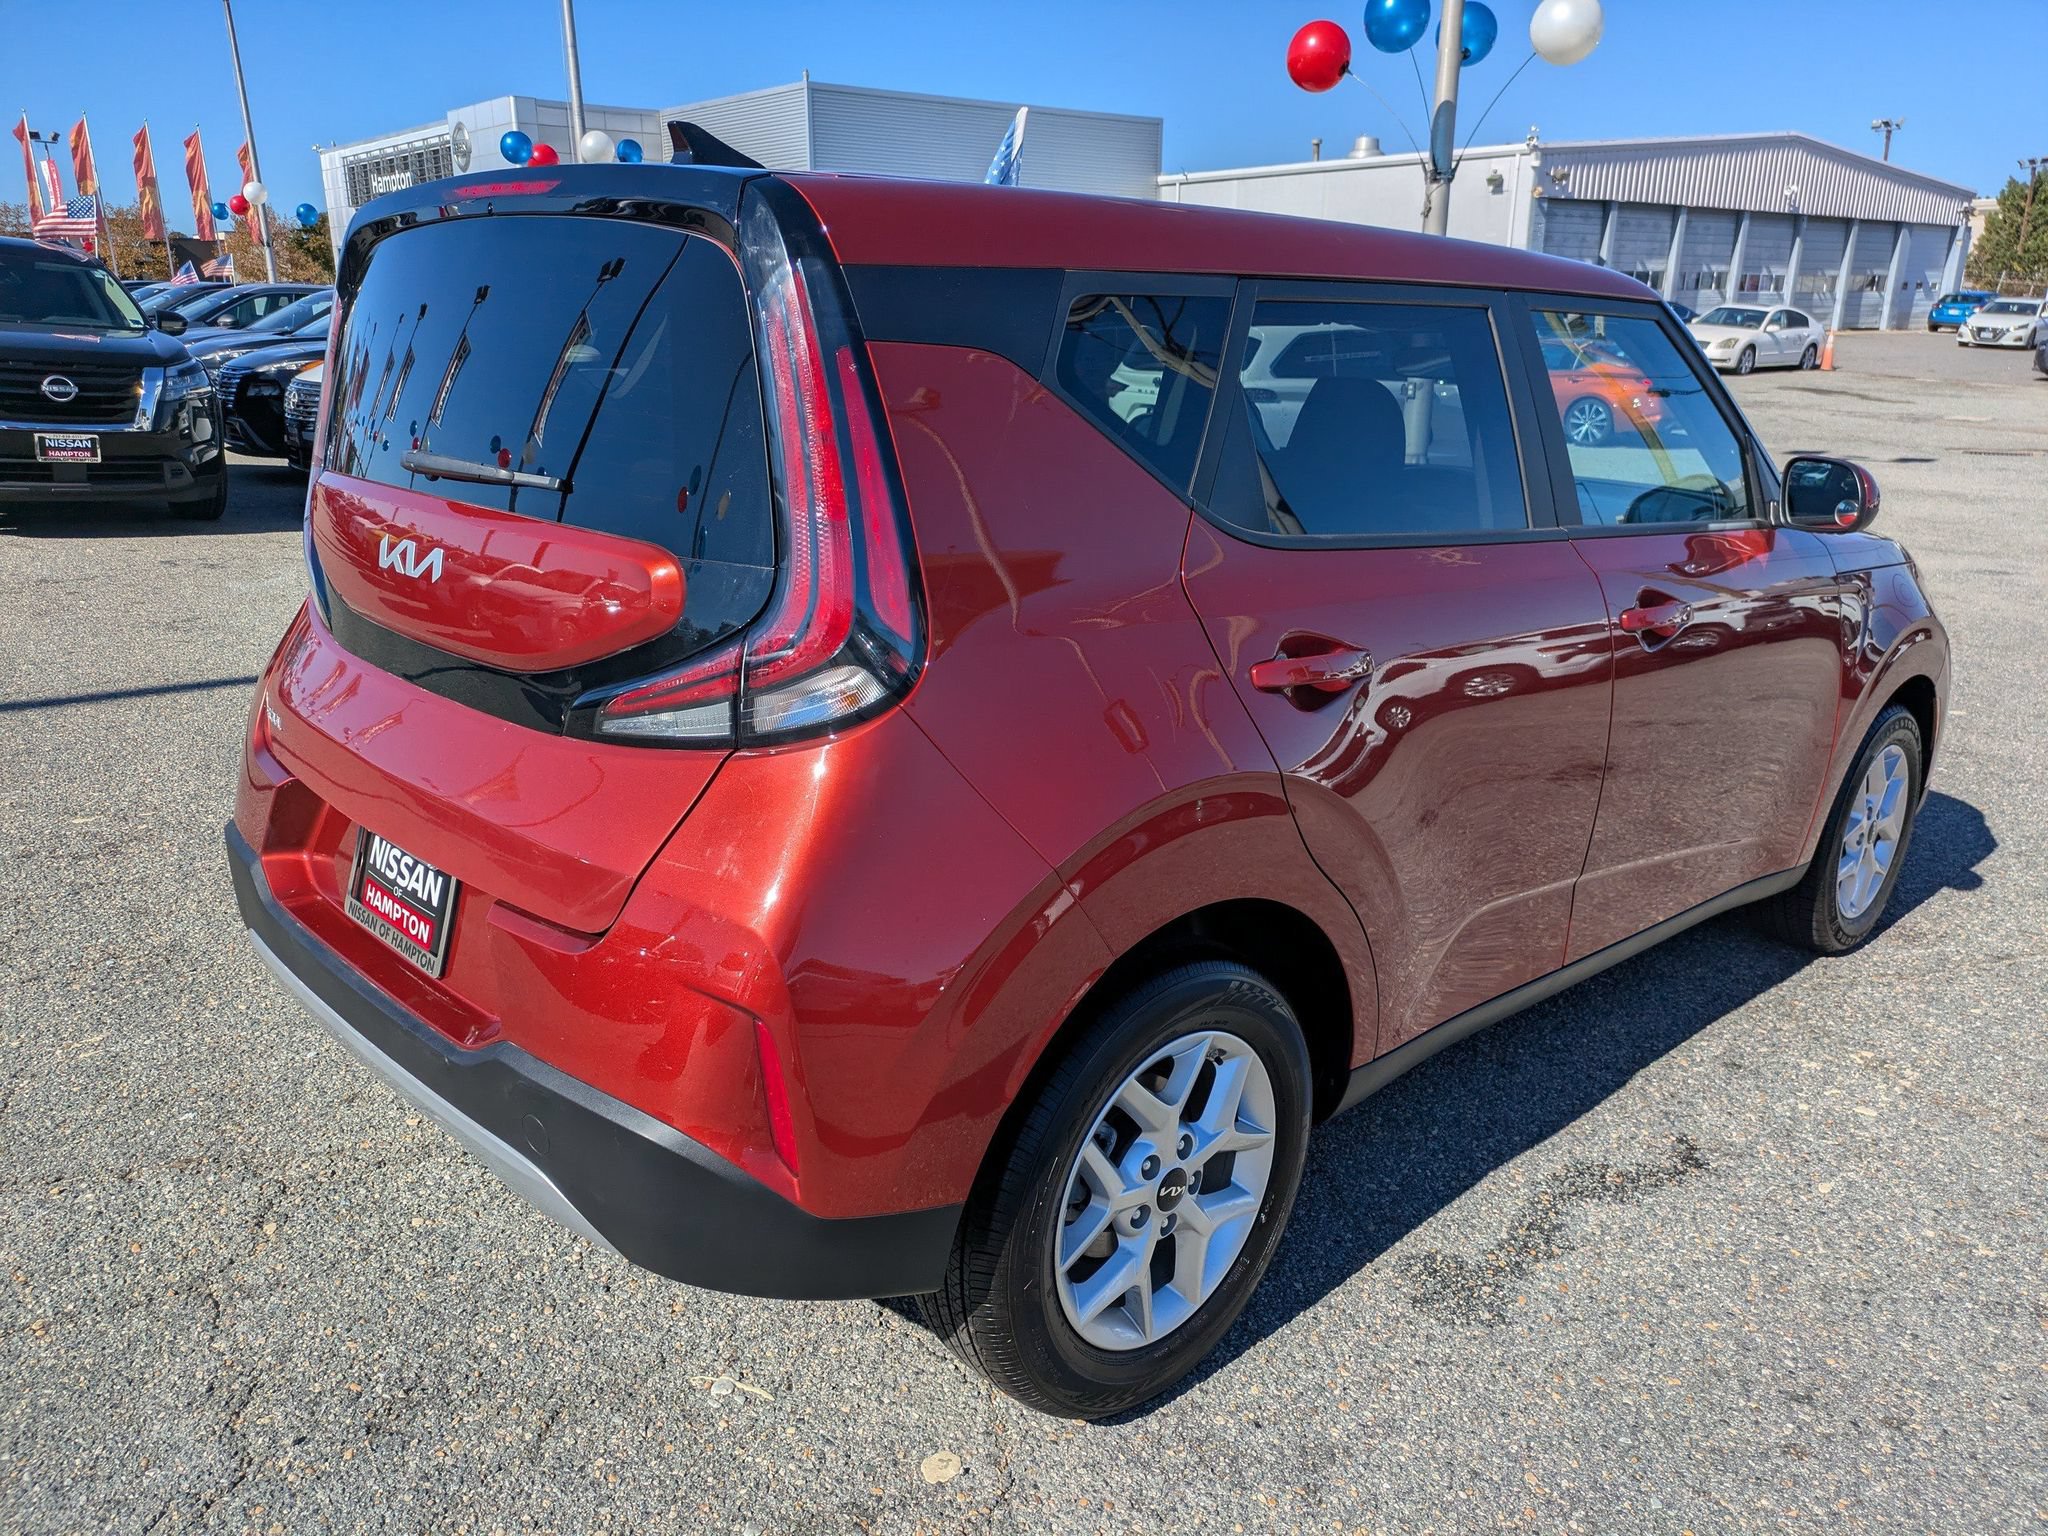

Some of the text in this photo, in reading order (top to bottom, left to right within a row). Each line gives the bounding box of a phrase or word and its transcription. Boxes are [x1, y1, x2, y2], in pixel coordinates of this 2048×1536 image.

[371, 171, 412, 193] Hampton
[41, 384, 78, 393] NISSAN
[45, 439, 91, 448] NISSAN
[378, 533, 444, 584] KIA
[369, 835, 443, 908] NISSAN
[393, 886, 403, 898] OF
[365, 884, 430, 944] HAMPTON
[348, 901, 436, 974] NISSAN OF HAMPTON
[1160, 1185, 1186, 1197] KIA
